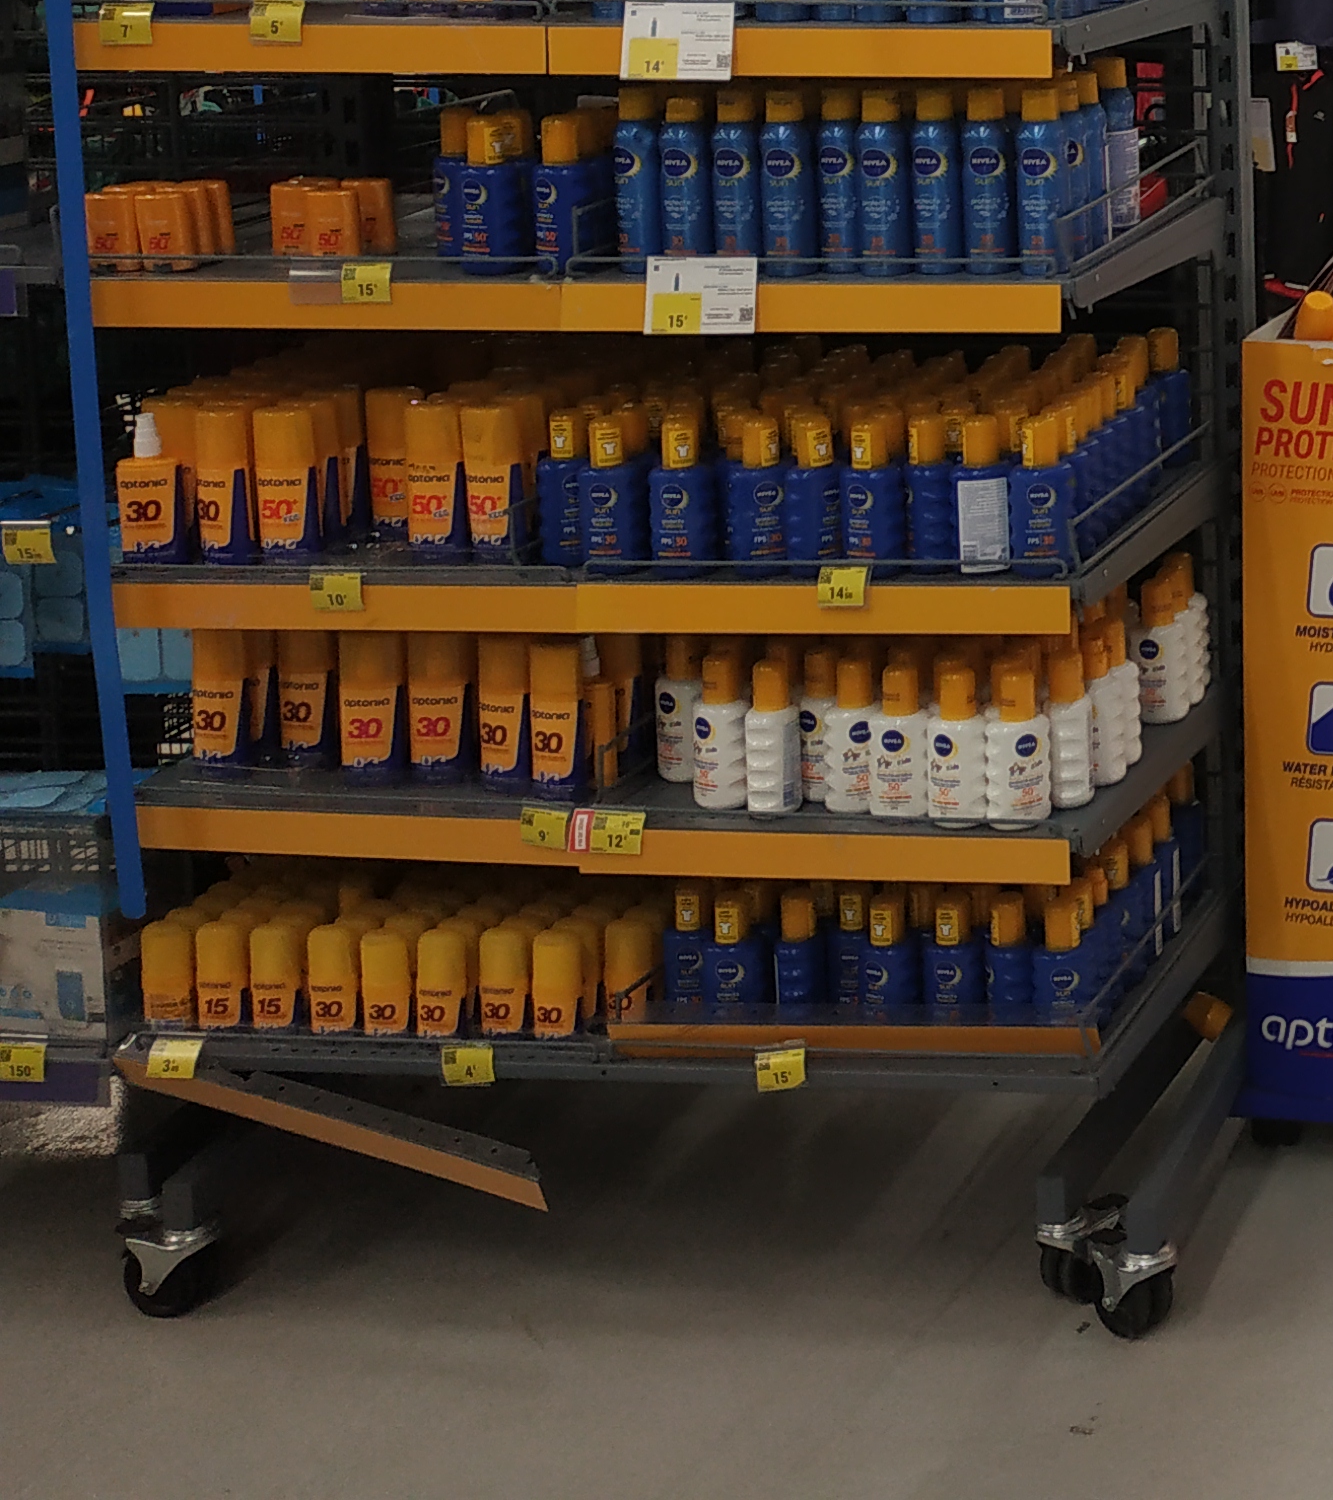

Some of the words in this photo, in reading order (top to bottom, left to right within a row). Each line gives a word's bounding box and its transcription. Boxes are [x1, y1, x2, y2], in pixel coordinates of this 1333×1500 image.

[120, 478, 168, 490] aptonia
[259, 478, 302, 490] aptonia
[409, 473, 450, 486] aptonia
[126, 500, 162, 523] 30
[344, 696, 390, 709] aptonia
[412, 696, 458, 708] aptonia
[195, 709, 226, 732] 30
[283, 701, 312, 724] 30
[531, 709, 571, 721] aptonia
[348, 717, 382, 740] 30
[417, 716, 451, 738] 30
[481, 722, 507, 746] 30
[534, 731, 563, 754] 30
[1283, 761, 1327, 778] WATER
[205, 998, 229, 1014] 15
[257, 998, 281, 1014] 15
[315, 1000, 343, 1018] 30
[369, 1003, 396, 1021] 30
[420, 1005, 445, 1023] 30
[484, 1002, 510, 1020] 30
[537, 1006, 562, 1024] 30
